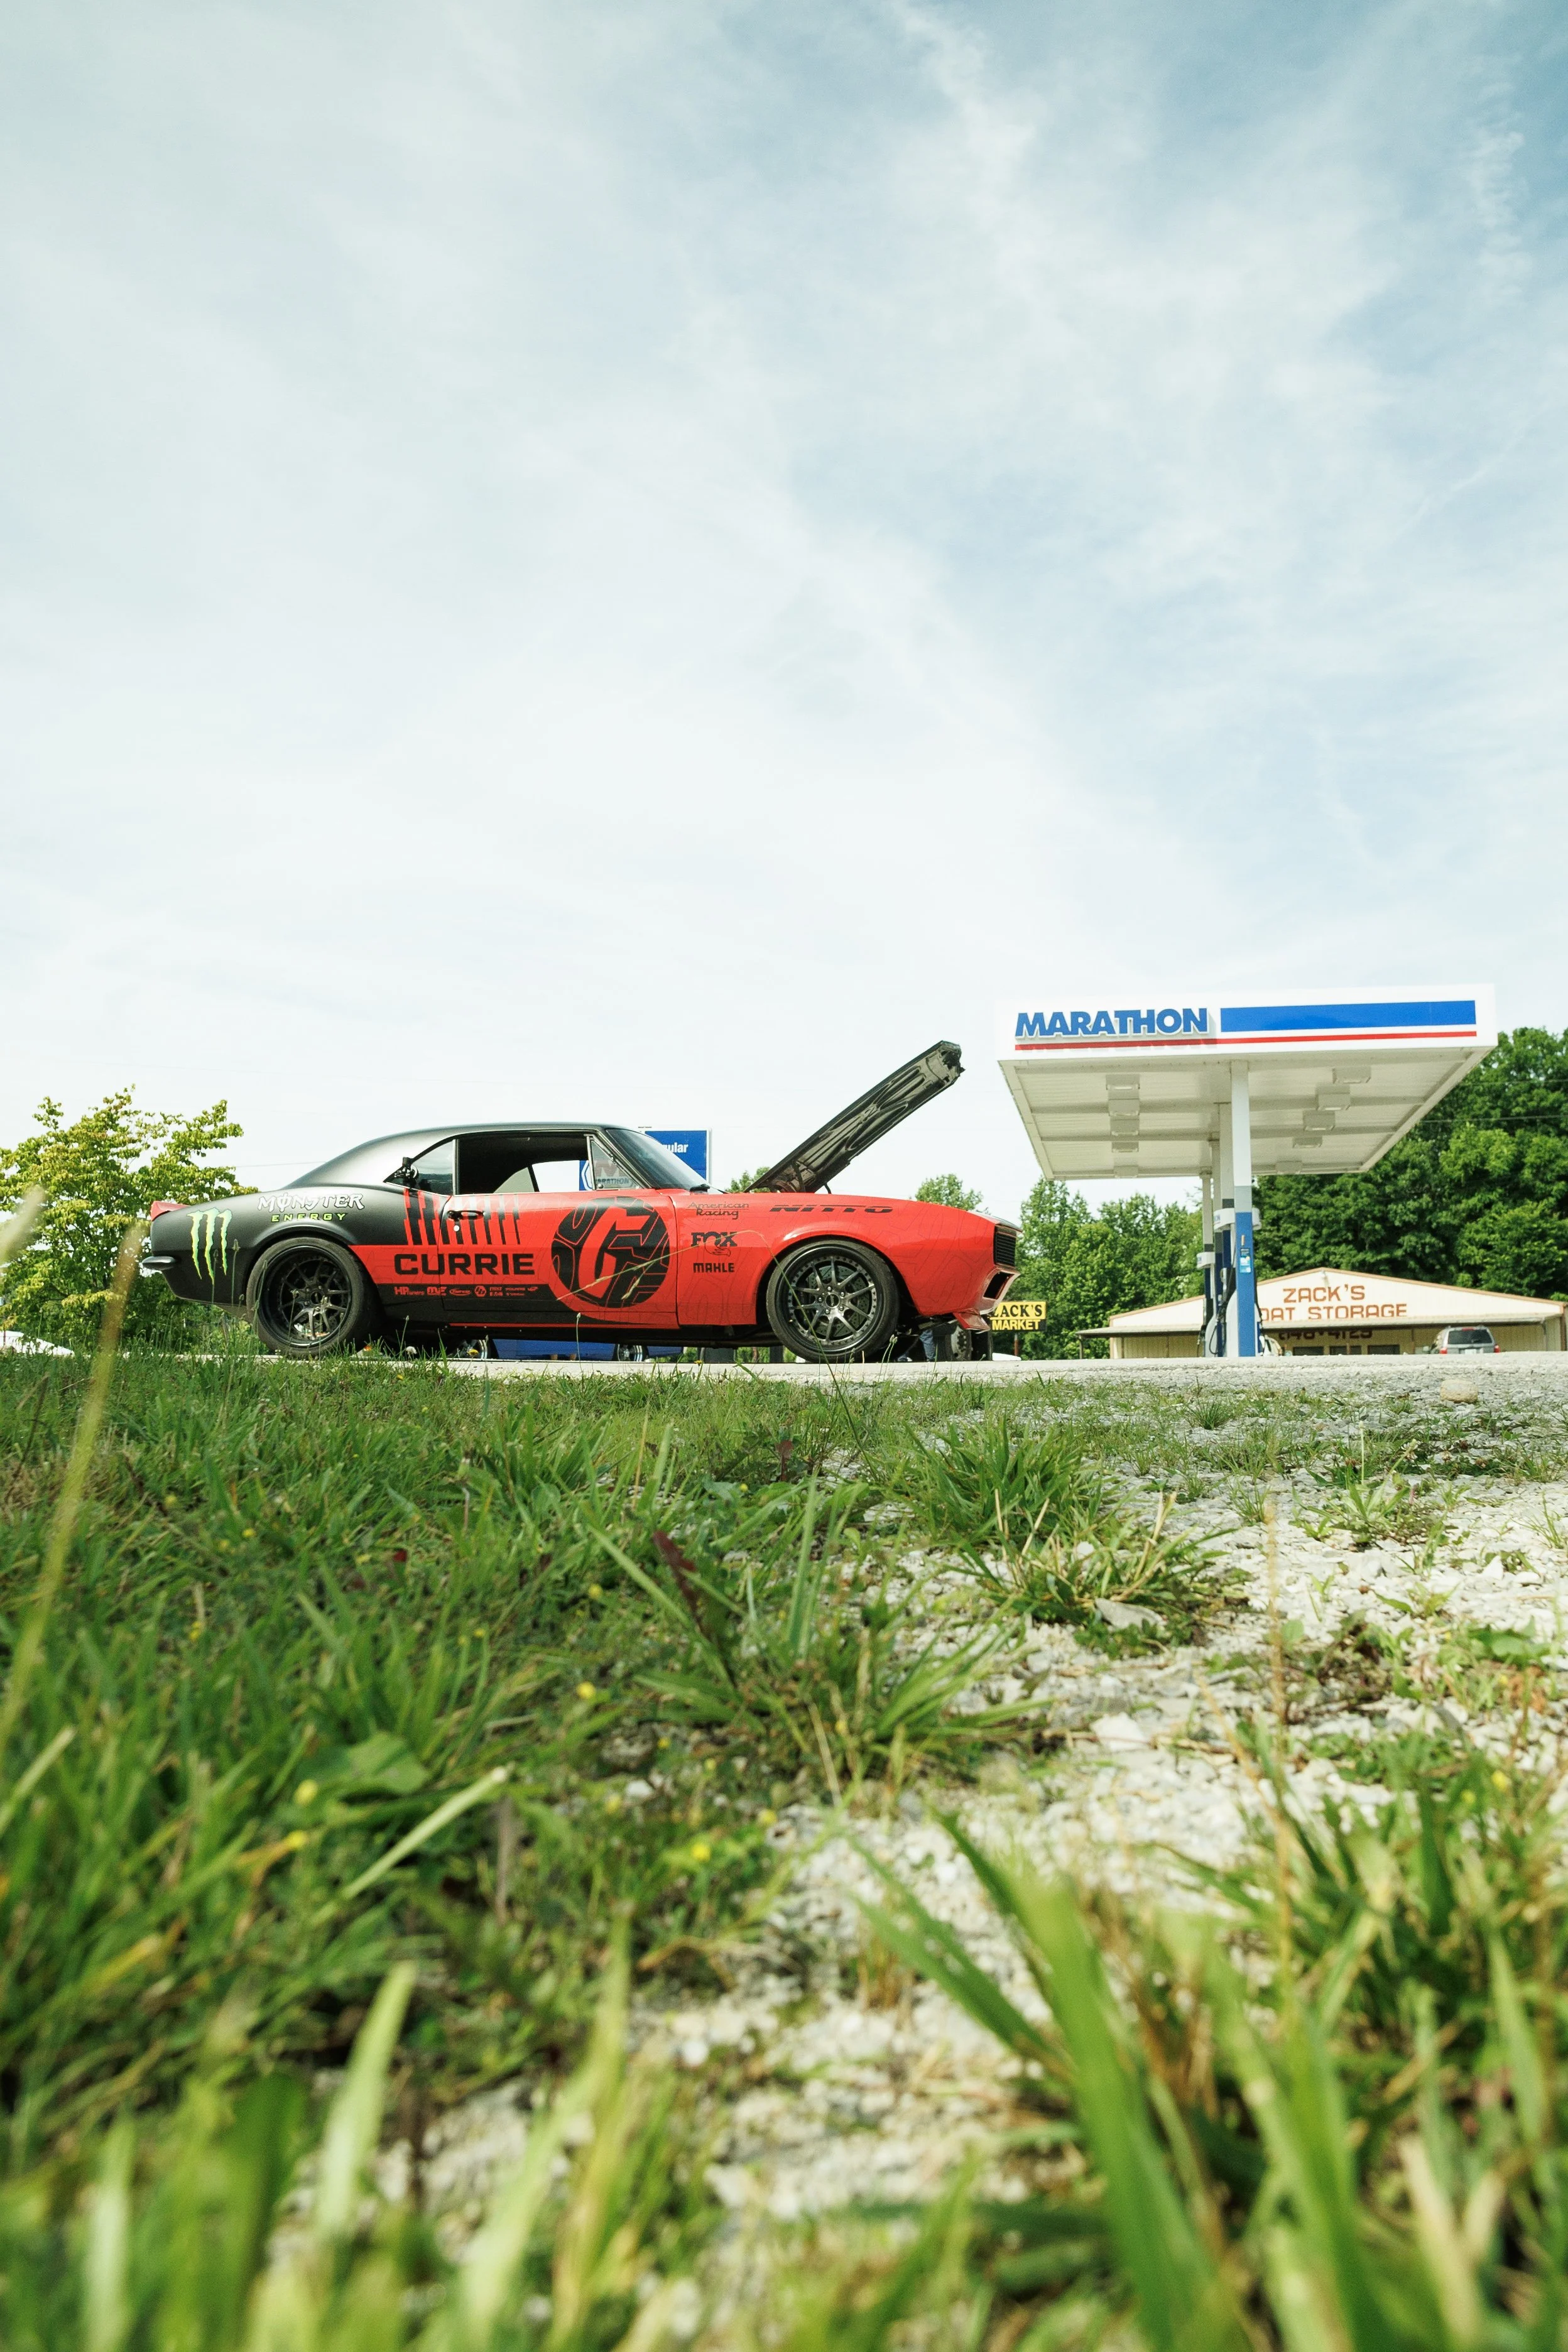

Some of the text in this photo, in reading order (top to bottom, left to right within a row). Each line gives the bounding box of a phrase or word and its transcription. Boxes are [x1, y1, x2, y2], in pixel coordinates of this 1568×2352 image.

[1015, 1008, 1208, 1037] MARATHON
[662, 1142, 689, 1153] ular
[257, 1192, 365, 1212] MONSTER
[770, 1204, 893, 1213] NITTO
[271, 1213, 346, 1222] ENERGY
[696, 1208, 739, 1220] Racing
[690, 1231, 738, 1248] FOX
[394, 1253, 535, 1275] CURRIE
[693, 1263, 735, 1273] MAHLE
[1283, 1284, 1365, 1303] ZACK'S
[1261, 1304, 1407, 1322] OAT STORAGE
[992, 1319, 1040, 1330] MARKET
